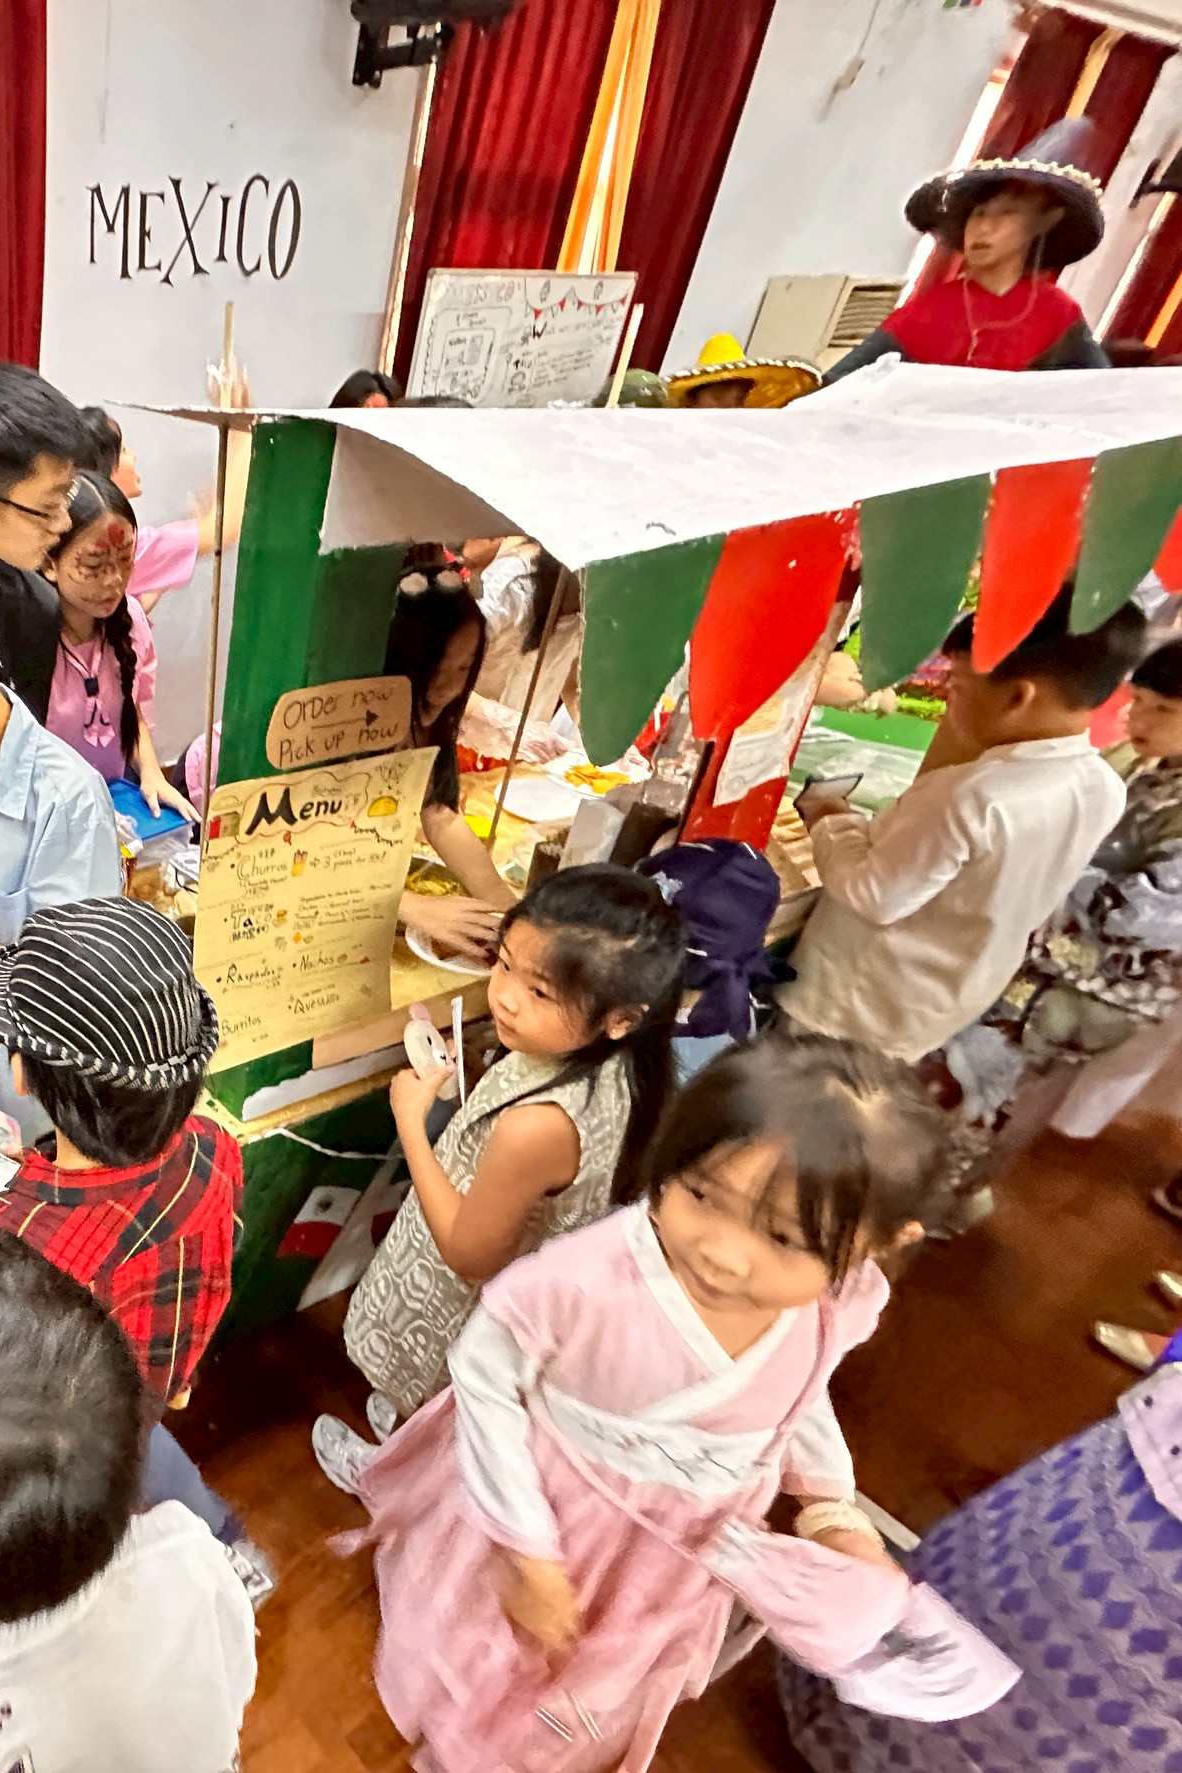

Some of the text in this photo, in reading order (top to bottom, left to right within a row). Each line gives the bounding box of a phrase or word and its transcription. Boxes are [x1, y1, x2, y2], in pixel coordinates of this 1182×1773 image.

[86, 173, 302, 287] MEXICO
[352, 687, 396, 707] now
[279, 722, 399, 767] Pick up now
[245, 787, 343, 836] Menu
[221, 1015, 262, 1037] Burritos
